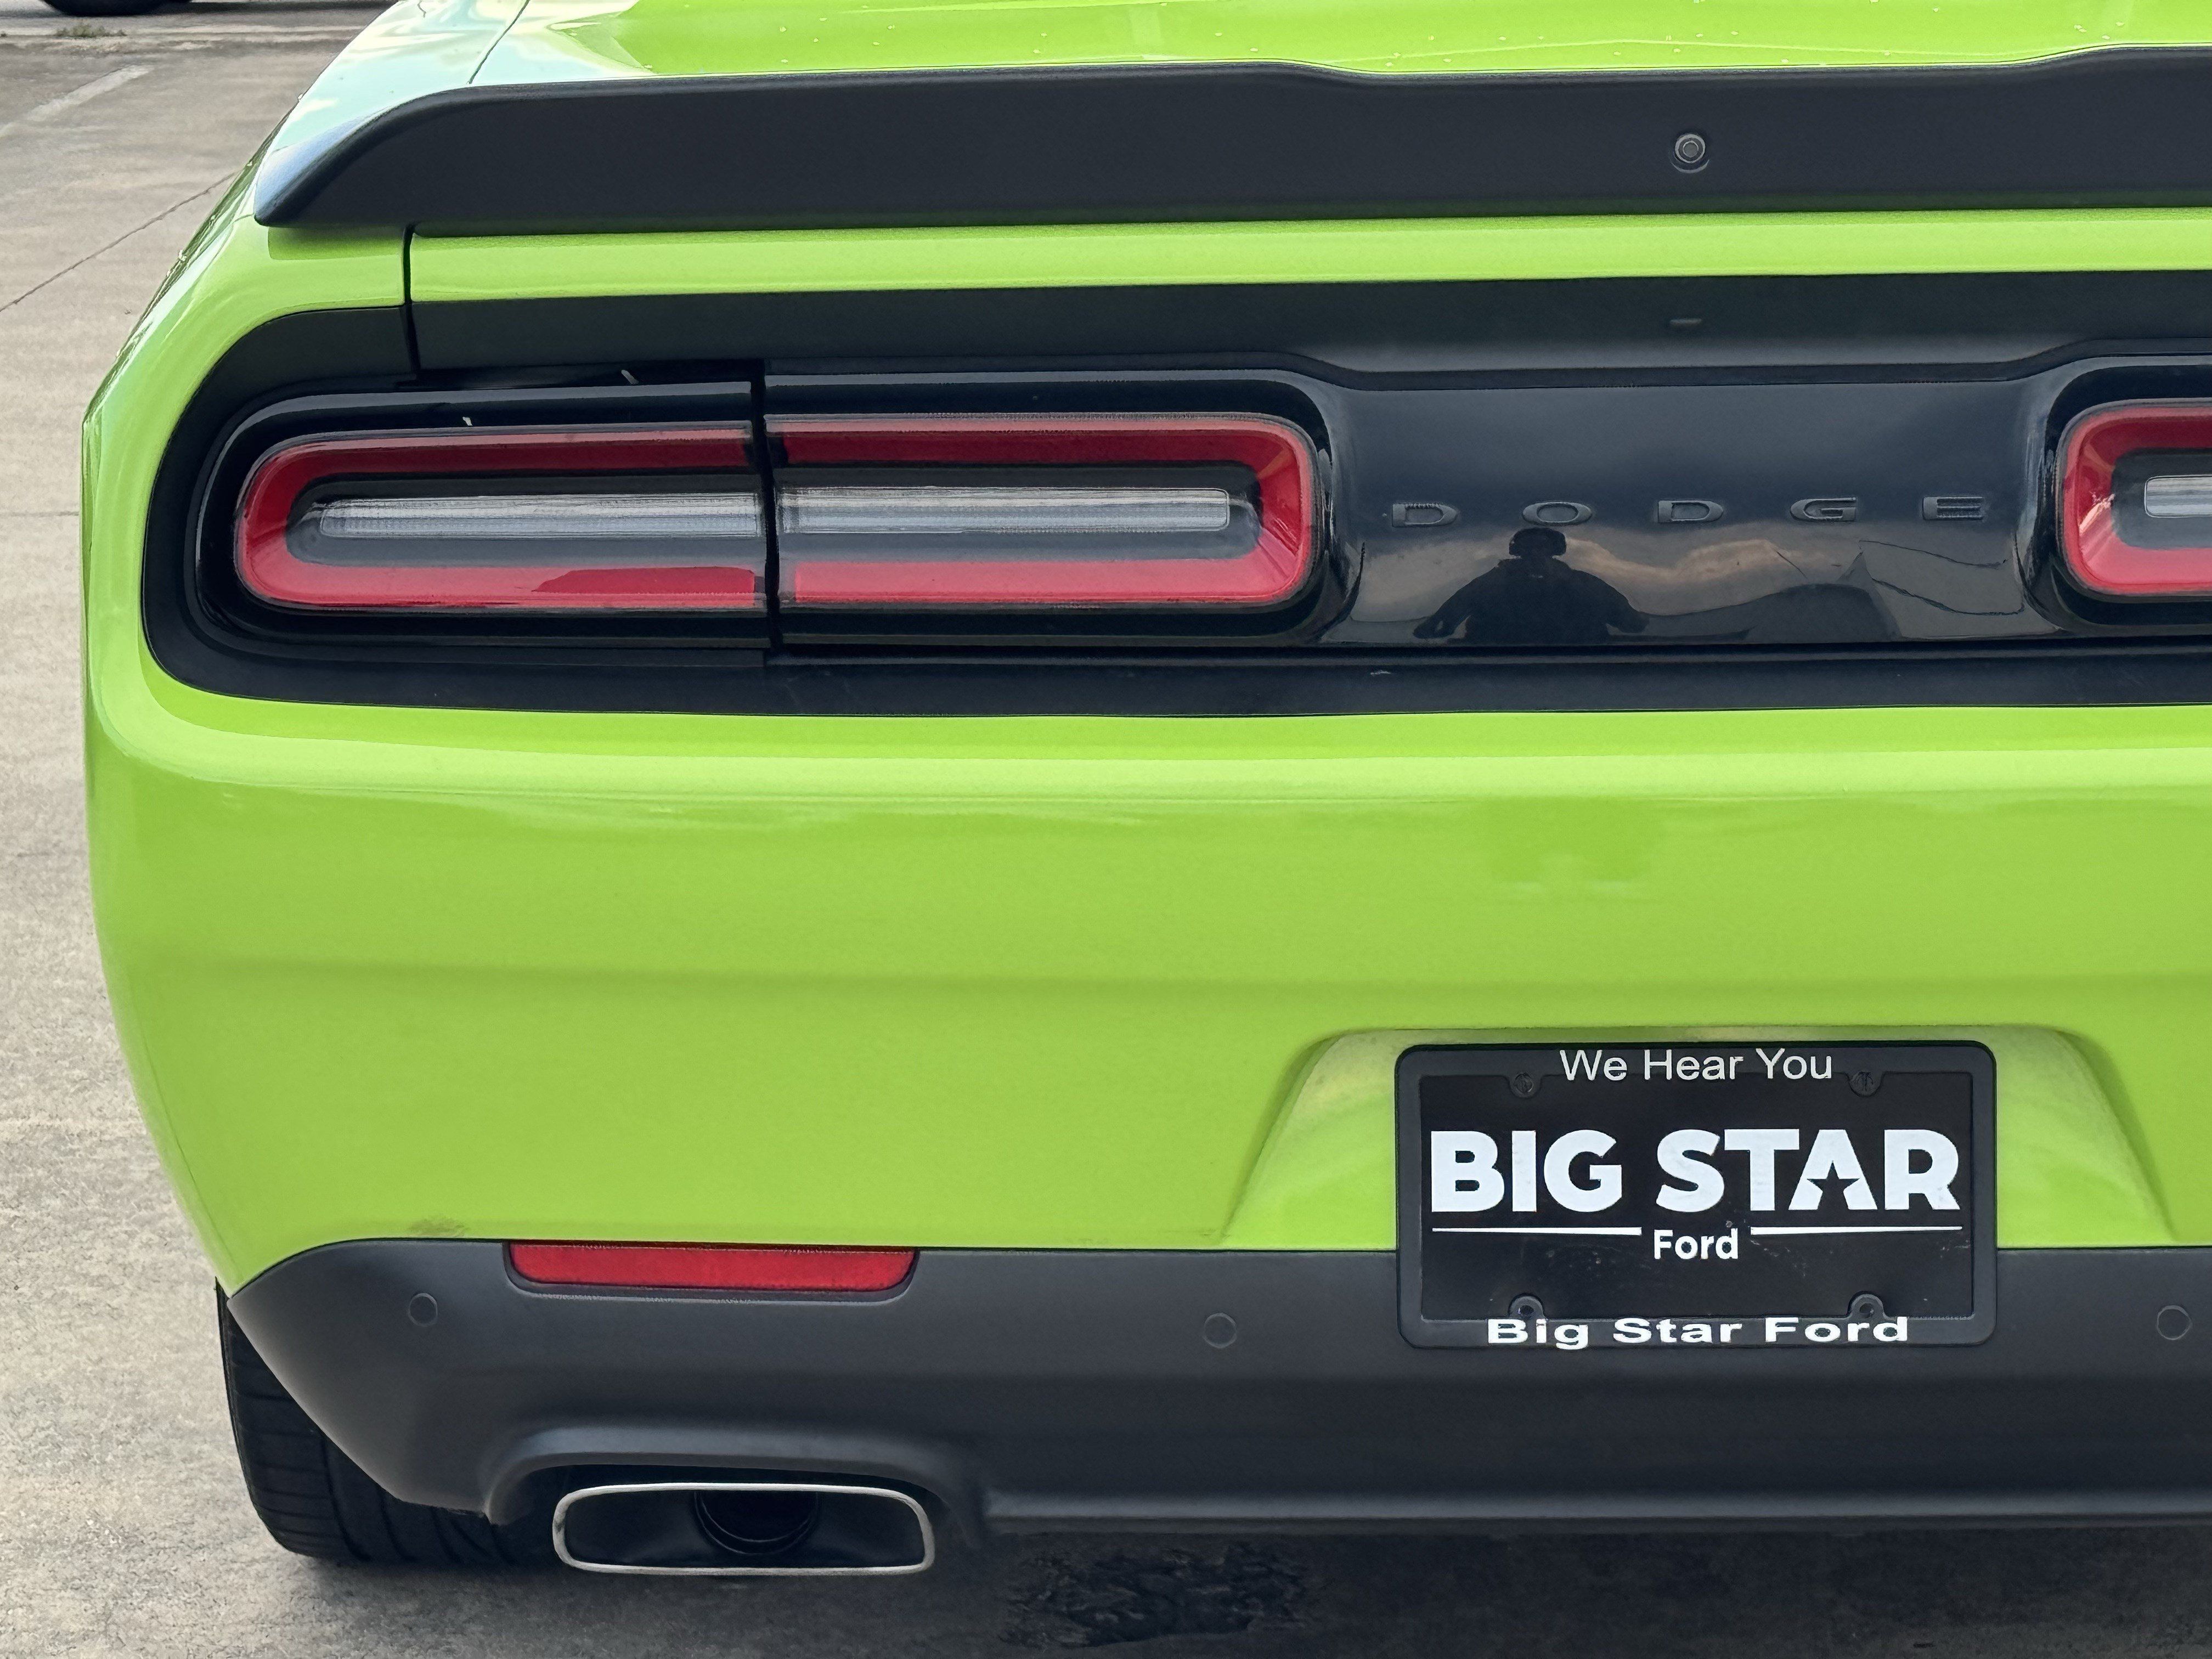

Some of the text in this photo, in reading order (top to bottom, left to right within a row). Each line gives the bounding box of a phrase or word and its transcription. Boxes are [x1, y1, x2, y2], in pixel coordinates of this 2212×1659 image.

[1391, 496, 1986, 528] DODGE
[1559, 1048, 1832, 1081] We Hear You
[1431, 1128, 1960, 1212] BIG STAR
[1654, 1228, 1739, 1260] Ford
[1488, 1316, 1908, 1350] Big Star Ford
